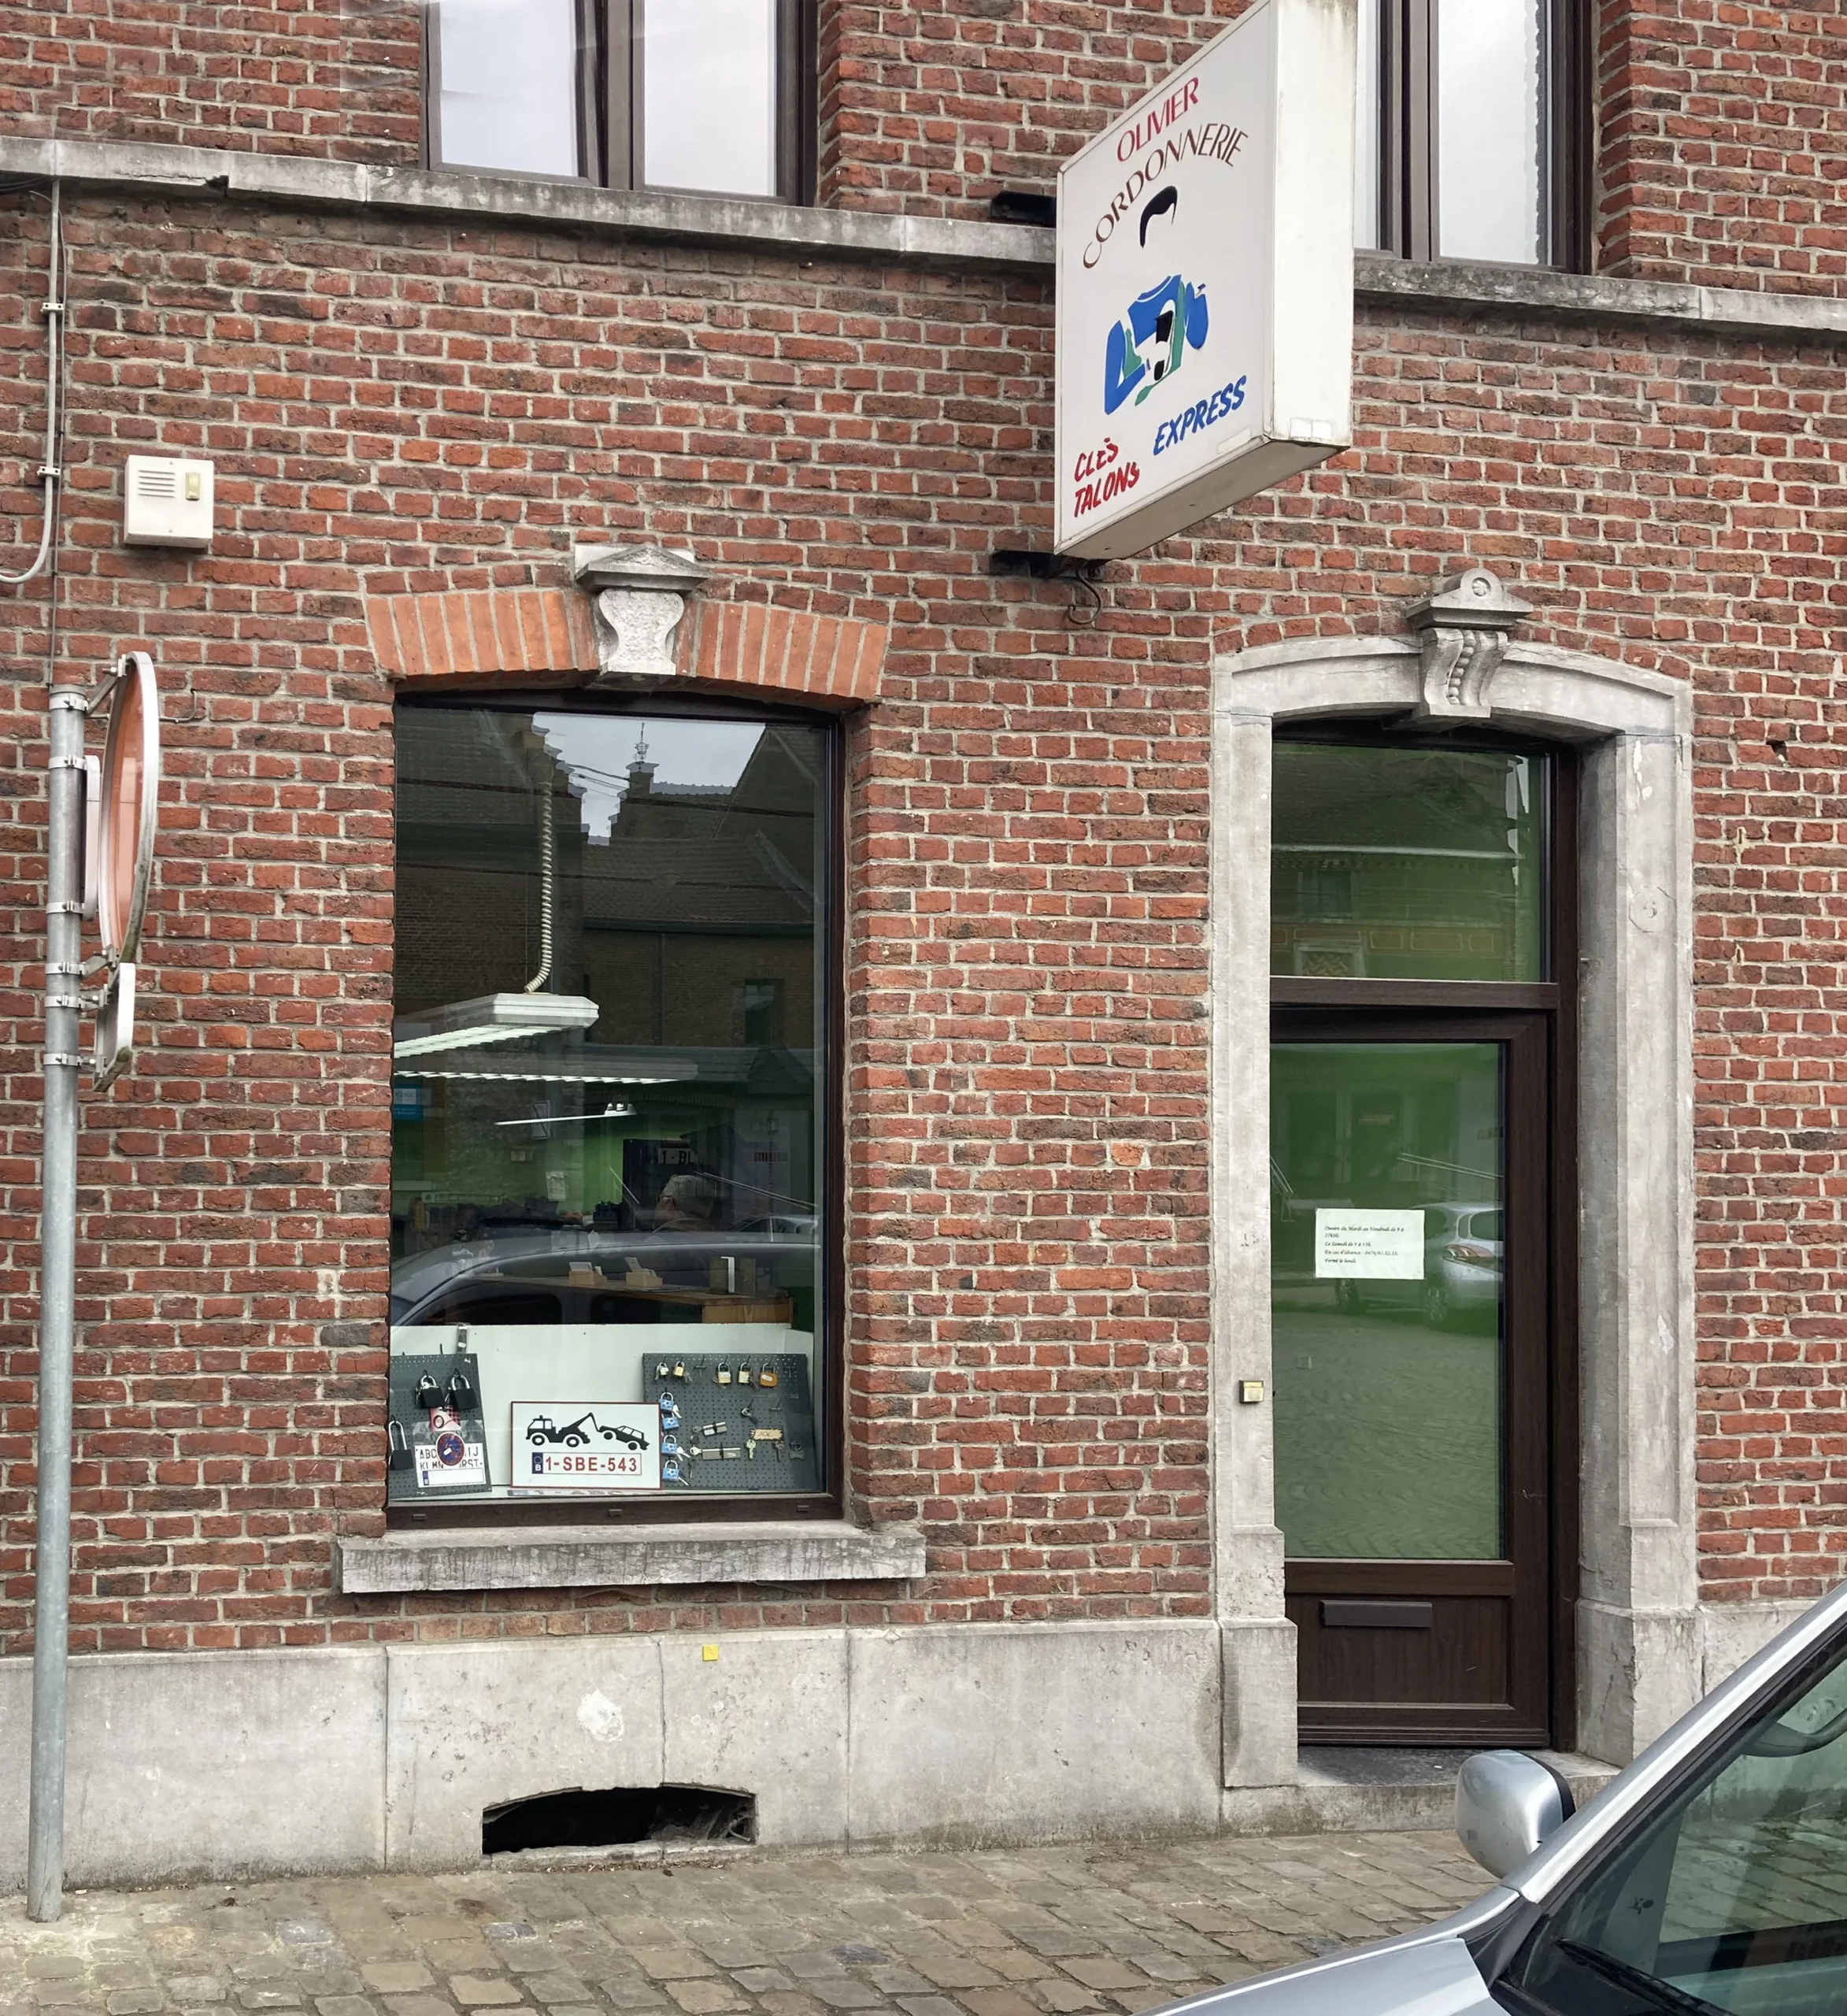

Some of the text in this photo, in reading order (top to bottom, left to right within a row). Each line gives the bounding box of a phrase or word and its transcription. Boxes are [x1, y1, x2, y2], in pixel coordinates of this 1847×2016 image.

[1116, 76, 1199, 161] OLIVIER
[1083, 123, 1249, 269] CORDONNERIE
[1153, 375, 1247, 456] EXPRESS
[1074, 461, 1140, 517] TALONS
[545, 1456, 637, 1472] 1-SBE-543
